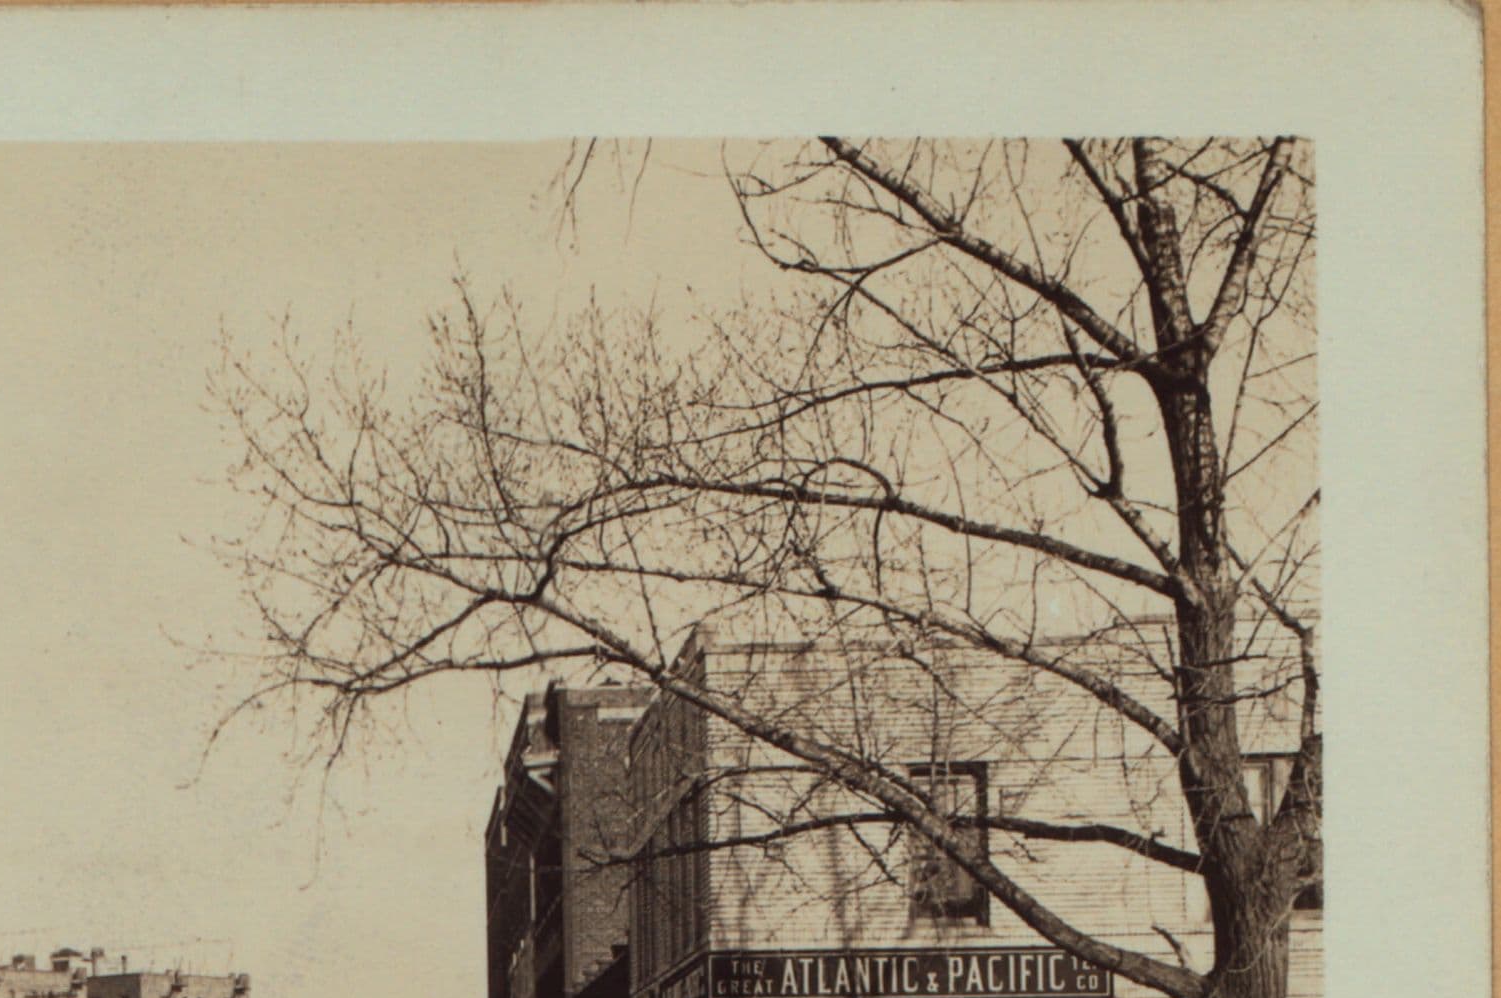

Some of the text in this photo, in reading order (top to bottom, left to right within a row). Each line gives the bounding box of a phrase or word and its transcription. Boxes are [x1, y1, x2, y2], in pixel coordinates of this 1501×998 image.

[731, 960, 762, 975] THE
[780, 954, 1066, 995] ATLANTIC & PACIFIC
[717, 978, 774, 995] GREAT
[1076, 974, 1099, 991] CO
